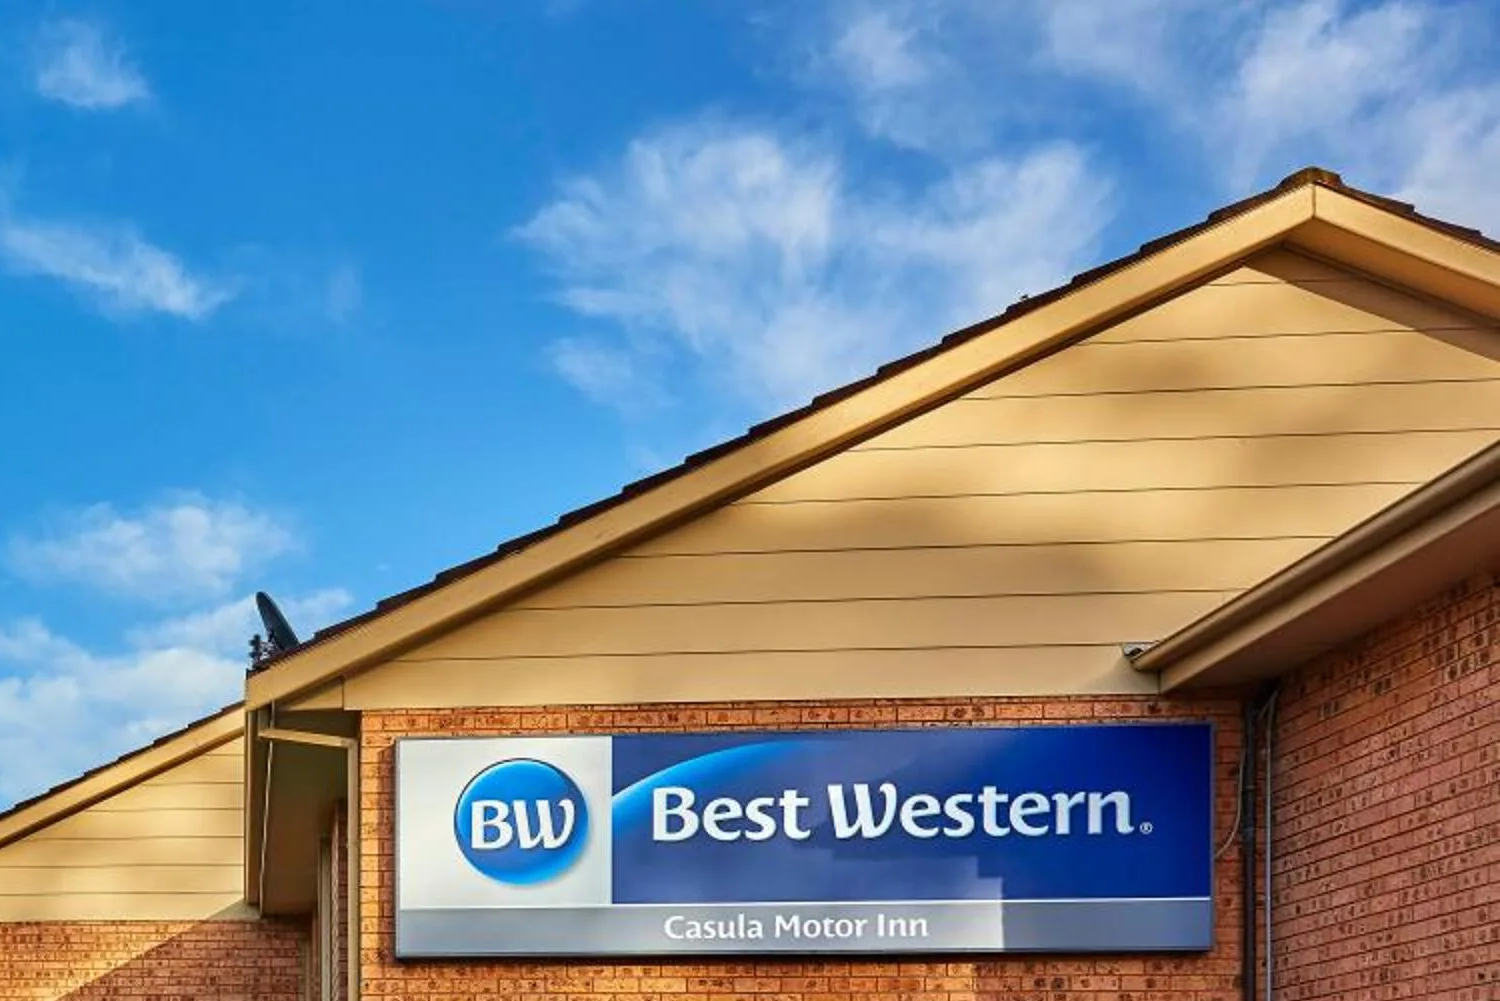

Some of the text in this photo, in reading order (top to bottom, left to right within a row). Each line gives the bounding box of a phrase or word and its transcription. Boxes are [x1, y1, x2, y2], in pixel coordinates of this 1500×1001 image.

[471, 799, 575, 850] BW
[652, 786, 811, 842] Best
[663, 913, 928, 940] Casula Motor Inn
